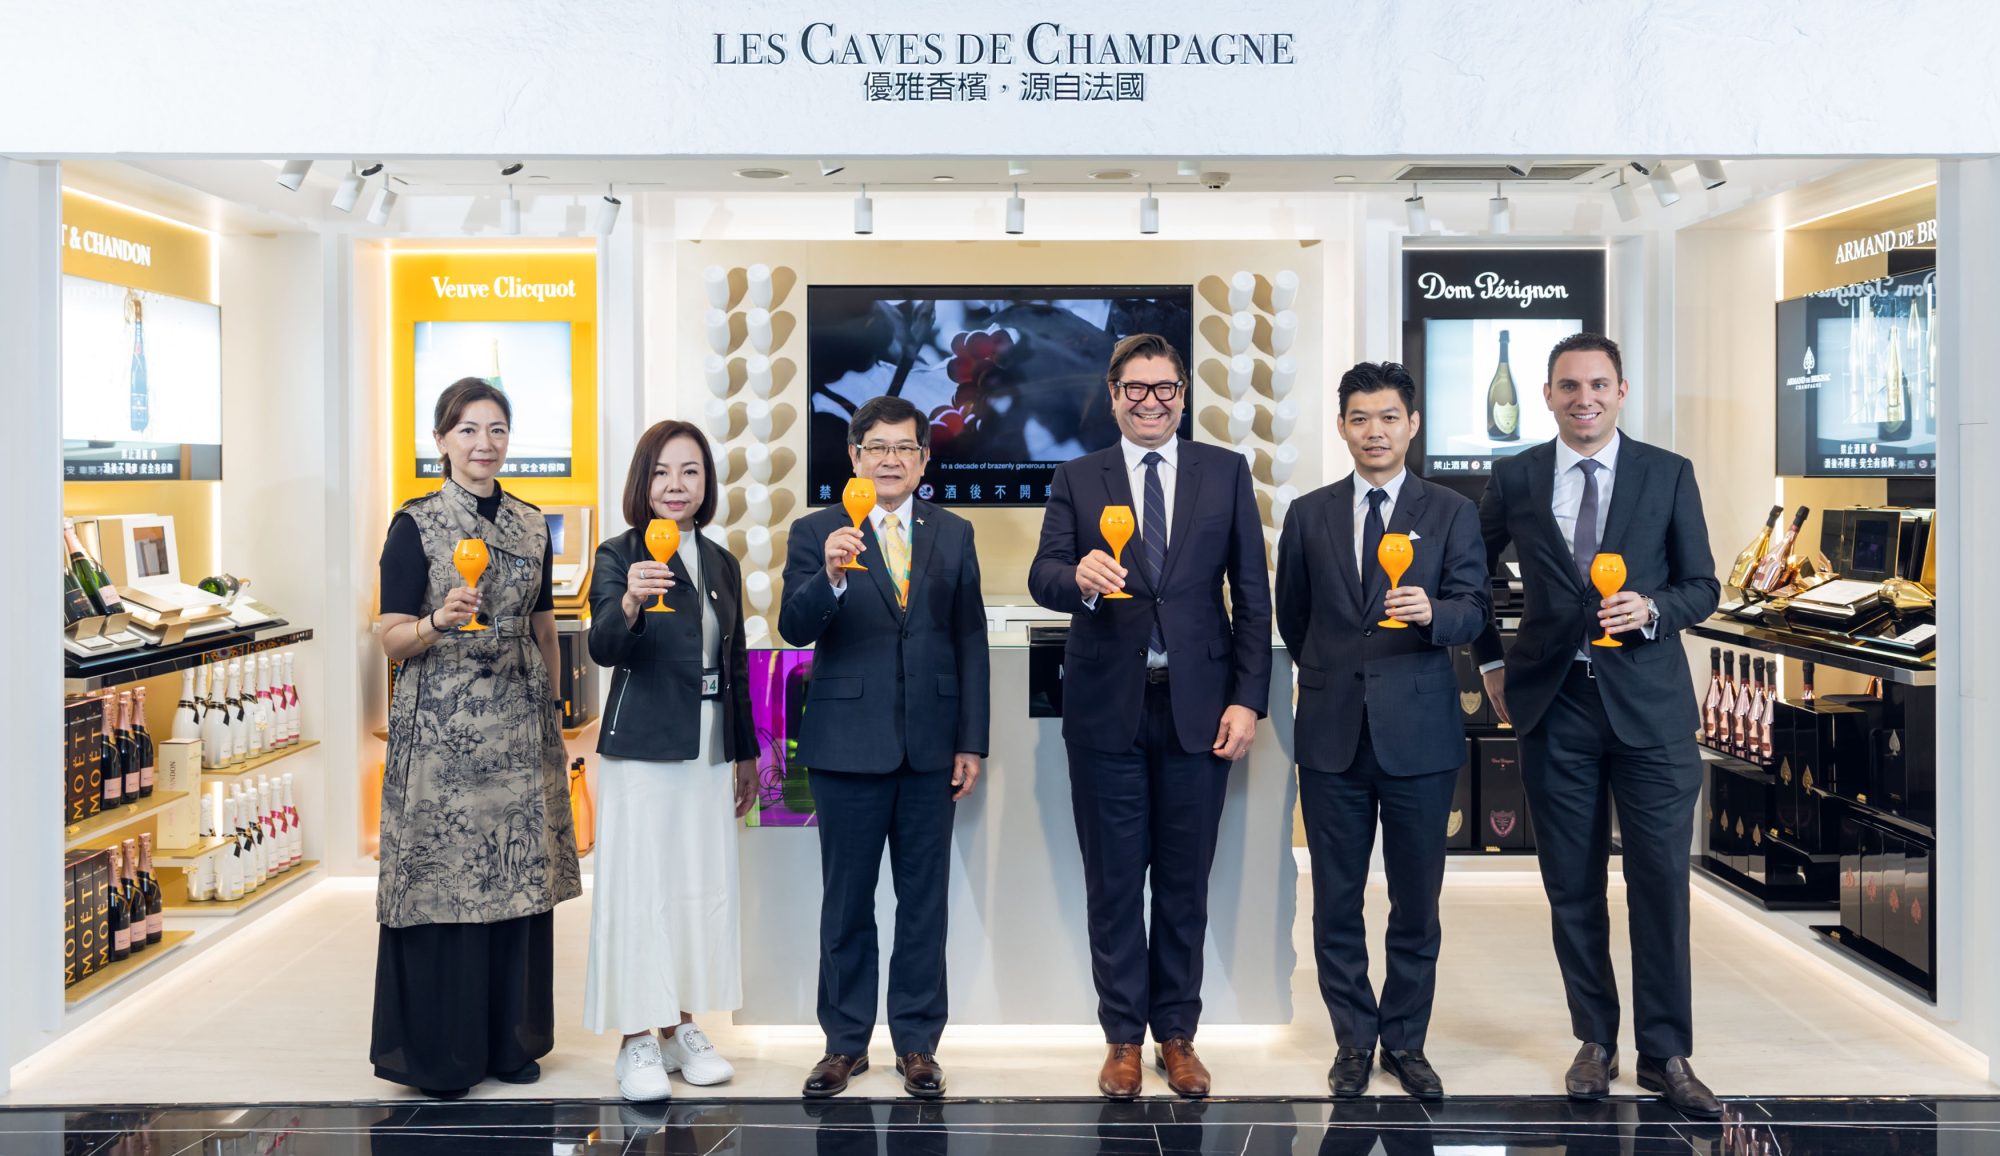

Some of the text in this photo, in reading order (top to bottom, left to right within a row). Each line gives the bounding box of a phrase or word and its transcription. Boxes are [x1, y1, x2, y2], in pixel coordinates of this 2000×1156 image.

[713, 22, 1294, 65] LES CAVES DE CHAMPAGNE
[62, 224, 151, 267] T & CHANDON
[1835, 218, 1937, 264] ARMAND DE BR
[431, 276, 577, 302] Veuve Clicquot
[1417, 271, 1569, 308] Dom Pérignon
[423, 463, 444, 473] 禁止
[941, 462, 948, 470] in
[1015, 463, 1045, 471] generous
[819, 484, 832, 500] 禁
[72, 731, 86, 820] MOËT
[88, 727, 101, 814] MOËT
[80, 887, 93, 976] MOËT
[97, 880, 109, 966] MOËT
